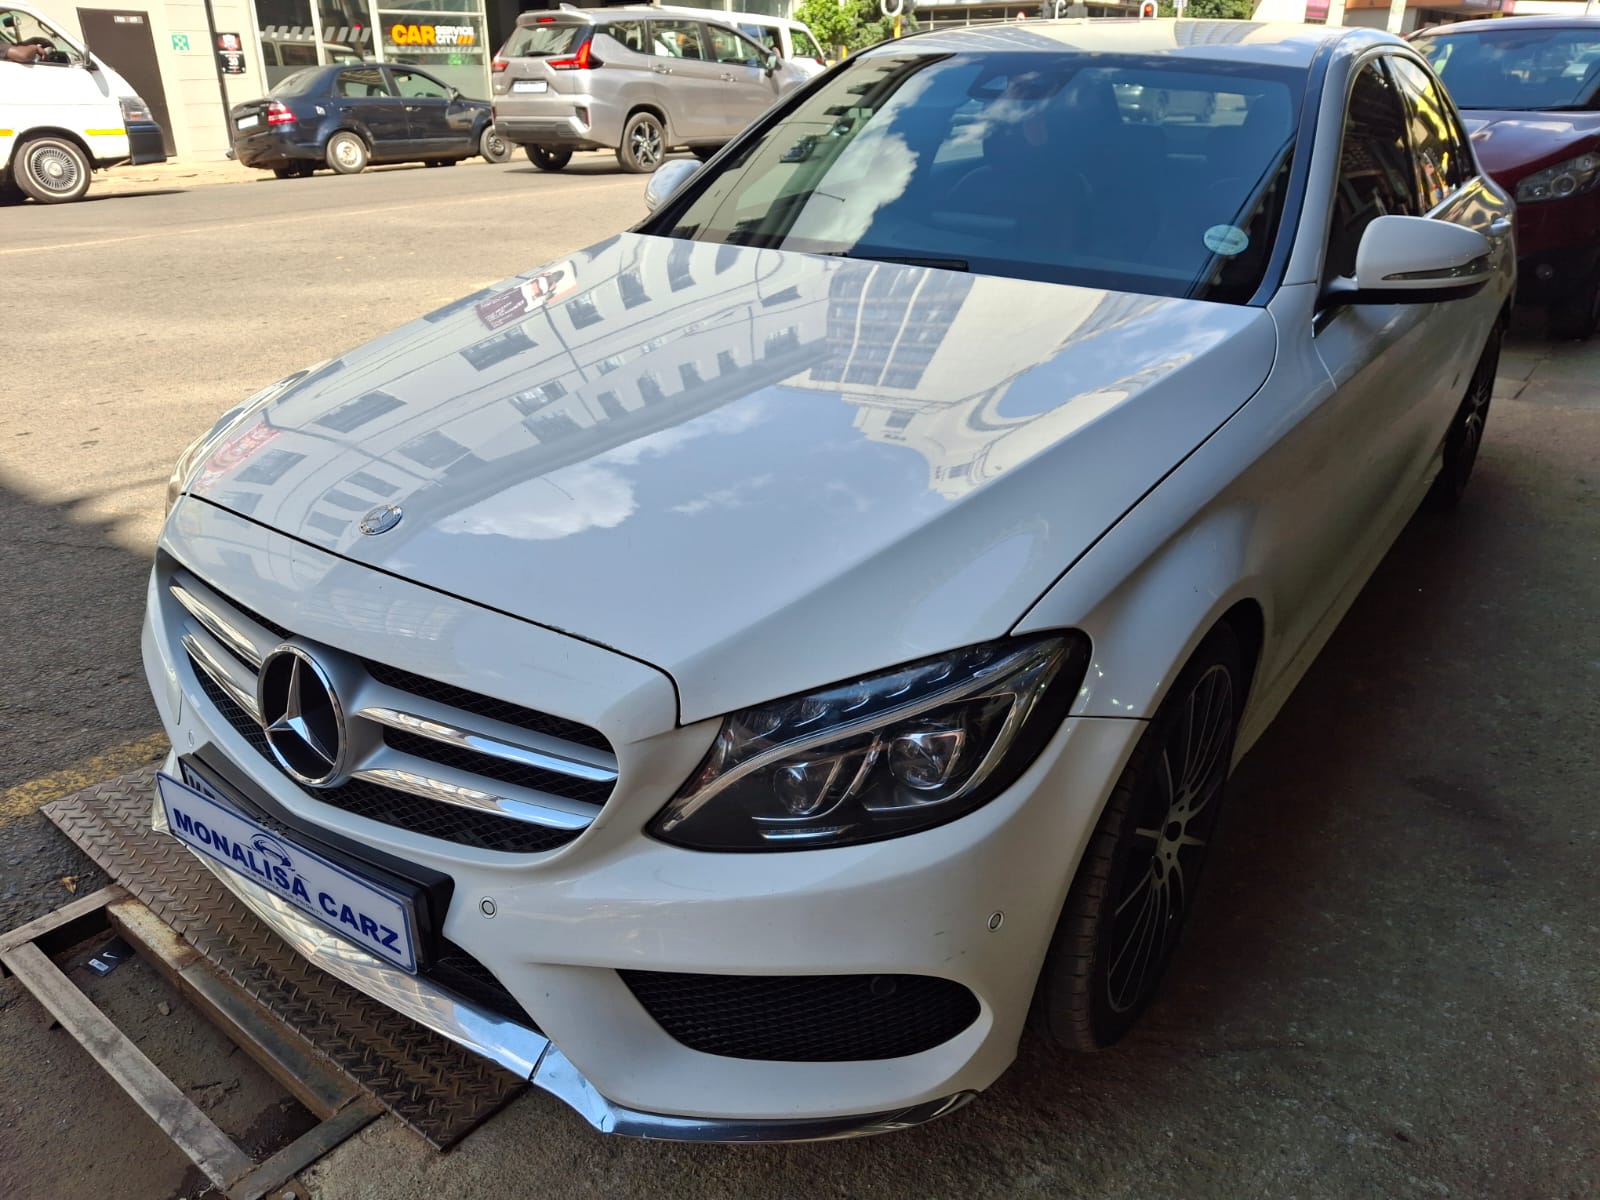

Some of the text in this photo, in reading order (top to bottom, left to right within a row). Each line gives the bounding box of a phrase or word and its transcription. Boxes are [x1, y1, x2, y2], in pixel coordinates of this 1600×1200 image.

[391, 24, 475, 46] CAR SERVICE
[435, 34, 458, 45] CITY
[173, 808, 402, 955] MONALISA CARZ
